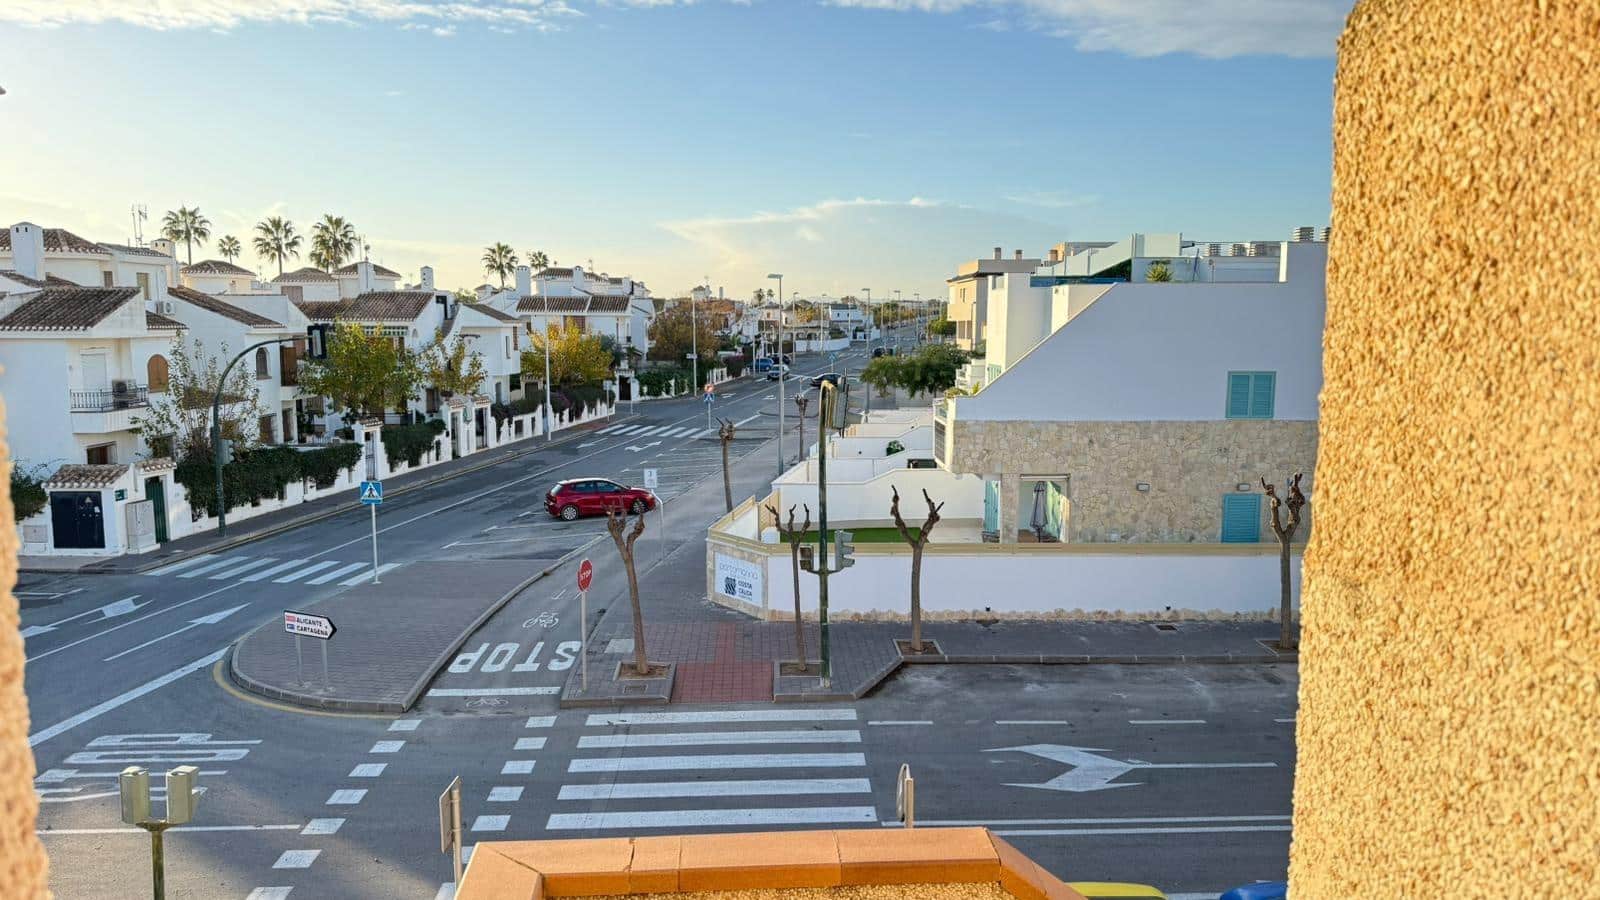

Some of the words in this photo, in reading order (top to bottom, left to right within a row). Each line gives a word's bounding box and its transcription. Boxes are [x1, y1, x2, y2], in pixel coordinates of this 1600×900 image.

[296, 616, 322, 627] ALICANTE
[296, 625, 329, 636] CARTAGENA
[448, 640, 583, 674] STOP
